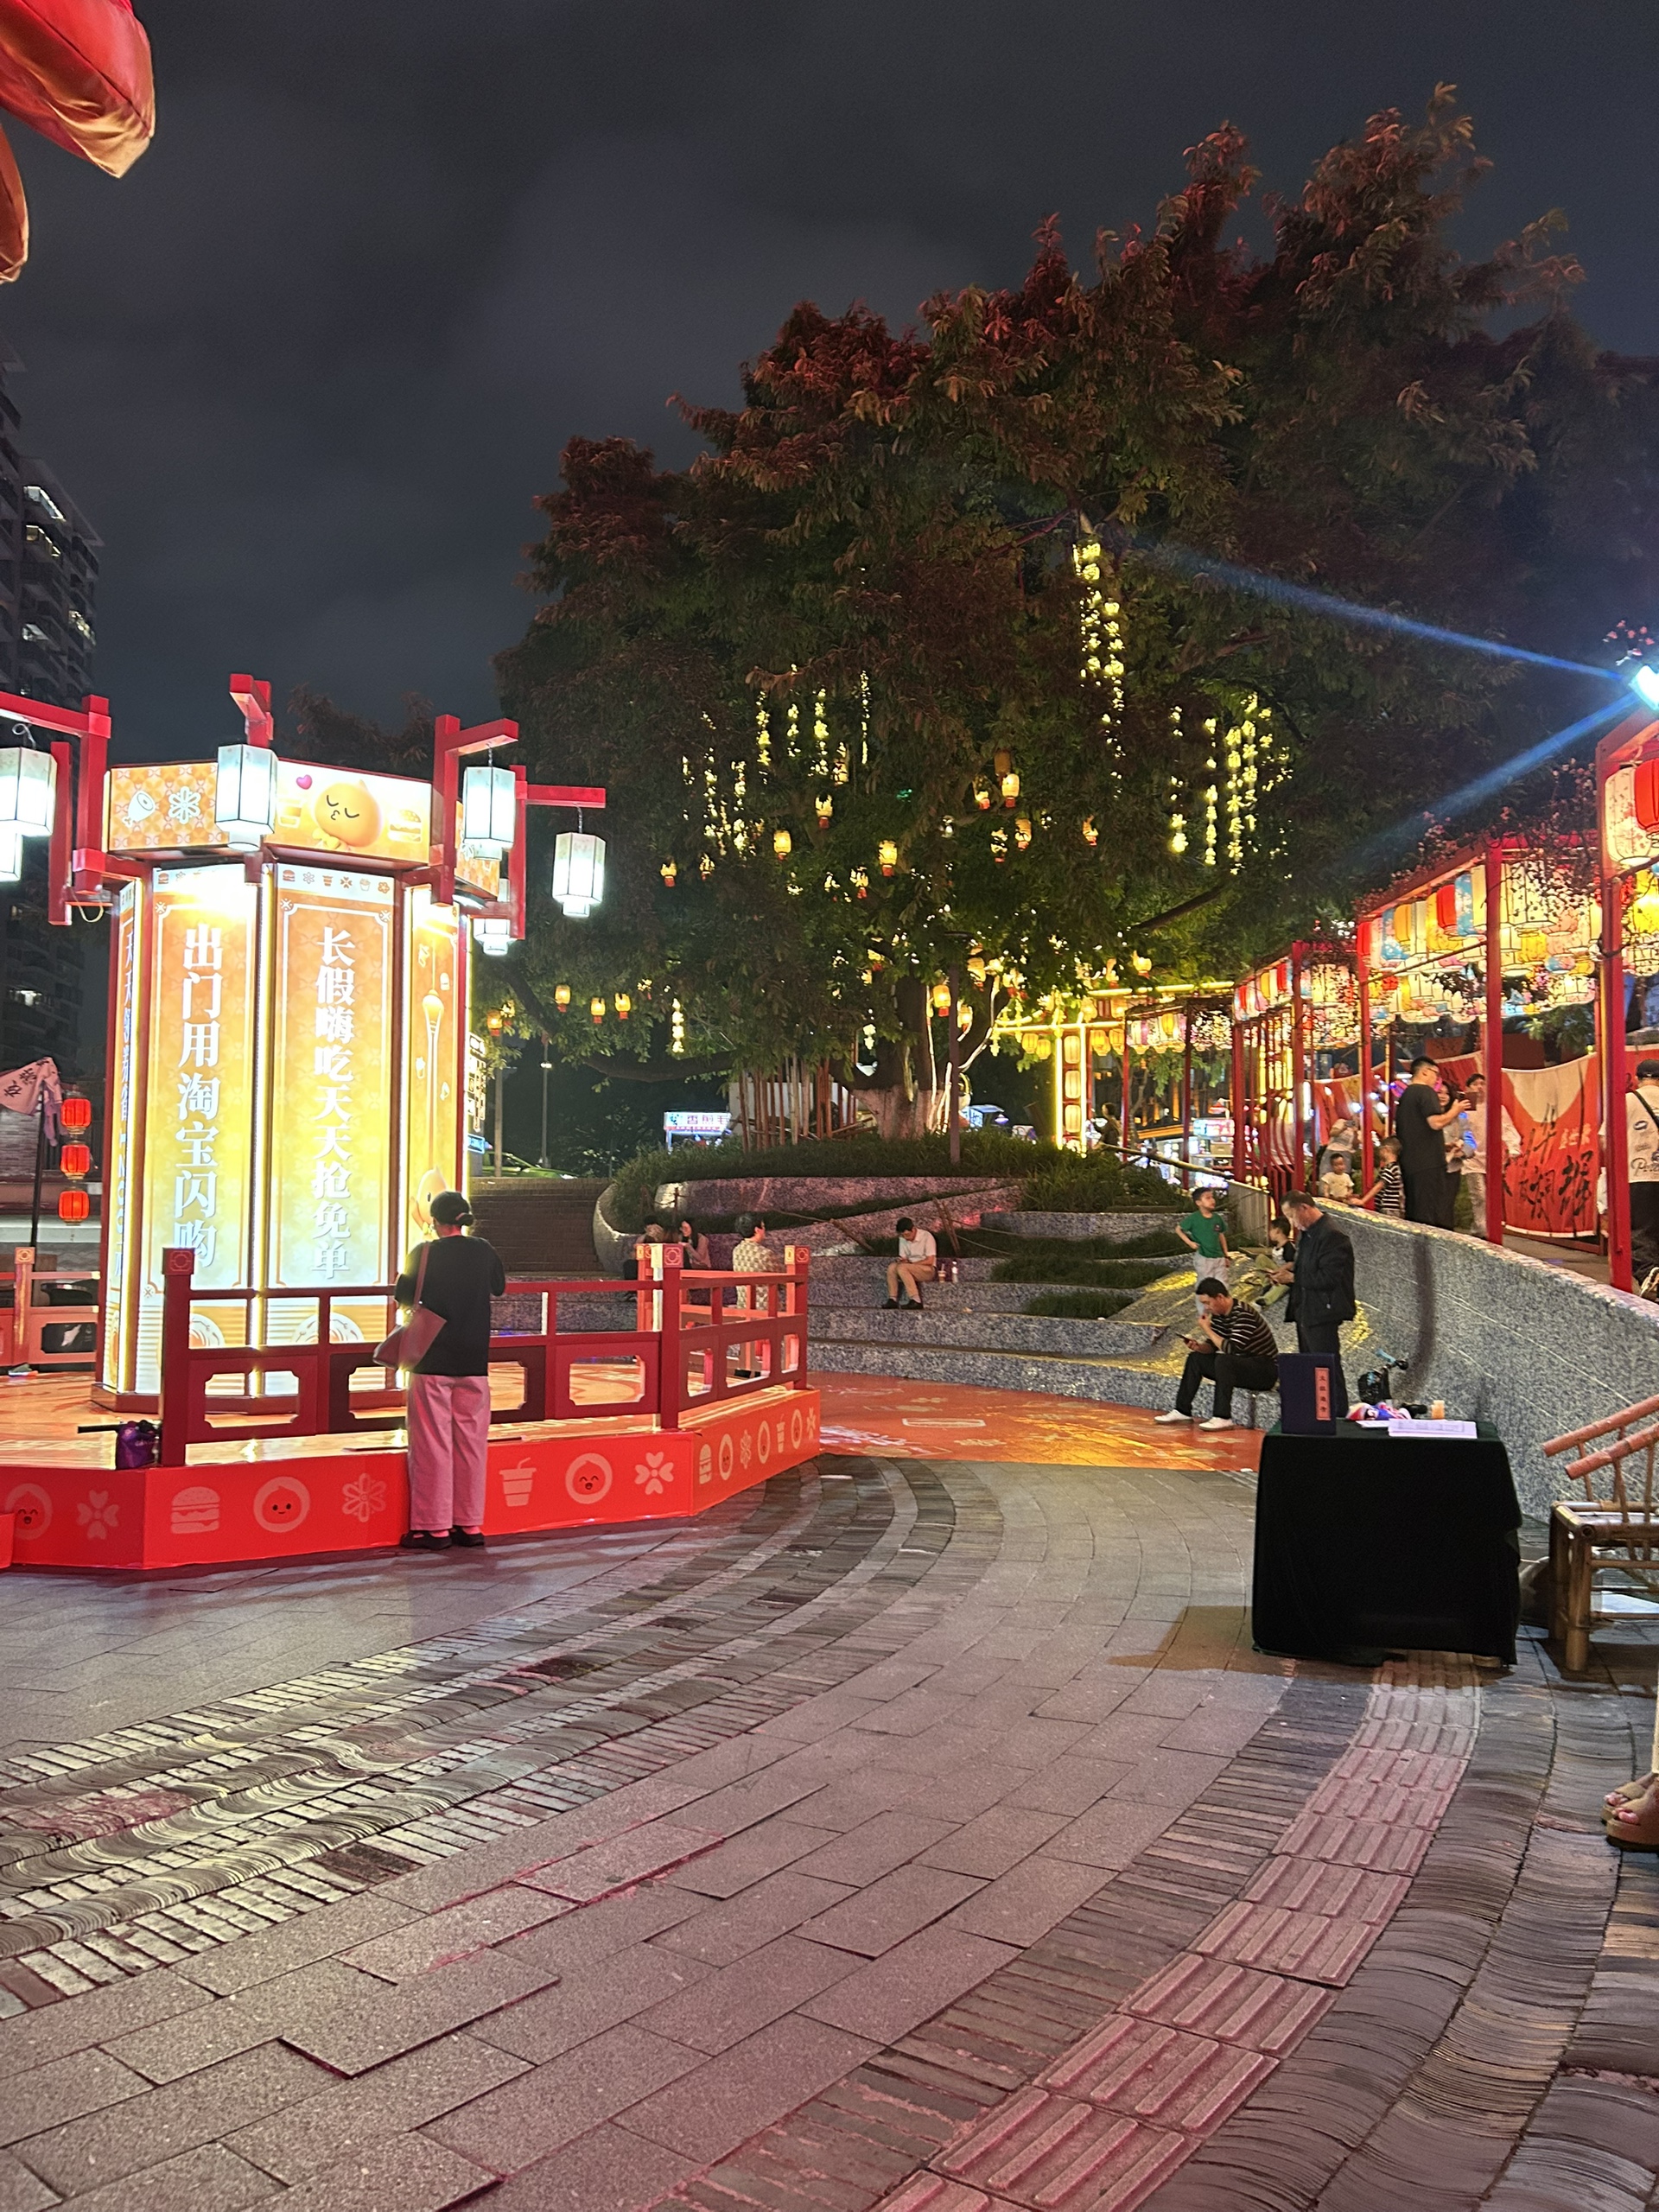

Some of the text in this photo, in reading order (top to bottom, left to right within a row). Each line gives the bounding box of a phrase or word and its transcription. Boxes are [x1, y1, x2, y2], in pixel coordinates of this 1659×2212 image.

[174, 924, 223, 1268] 出门用淘宝闪购
[311, 927, 355, 1279] 长假嗨吃天天抢免单
